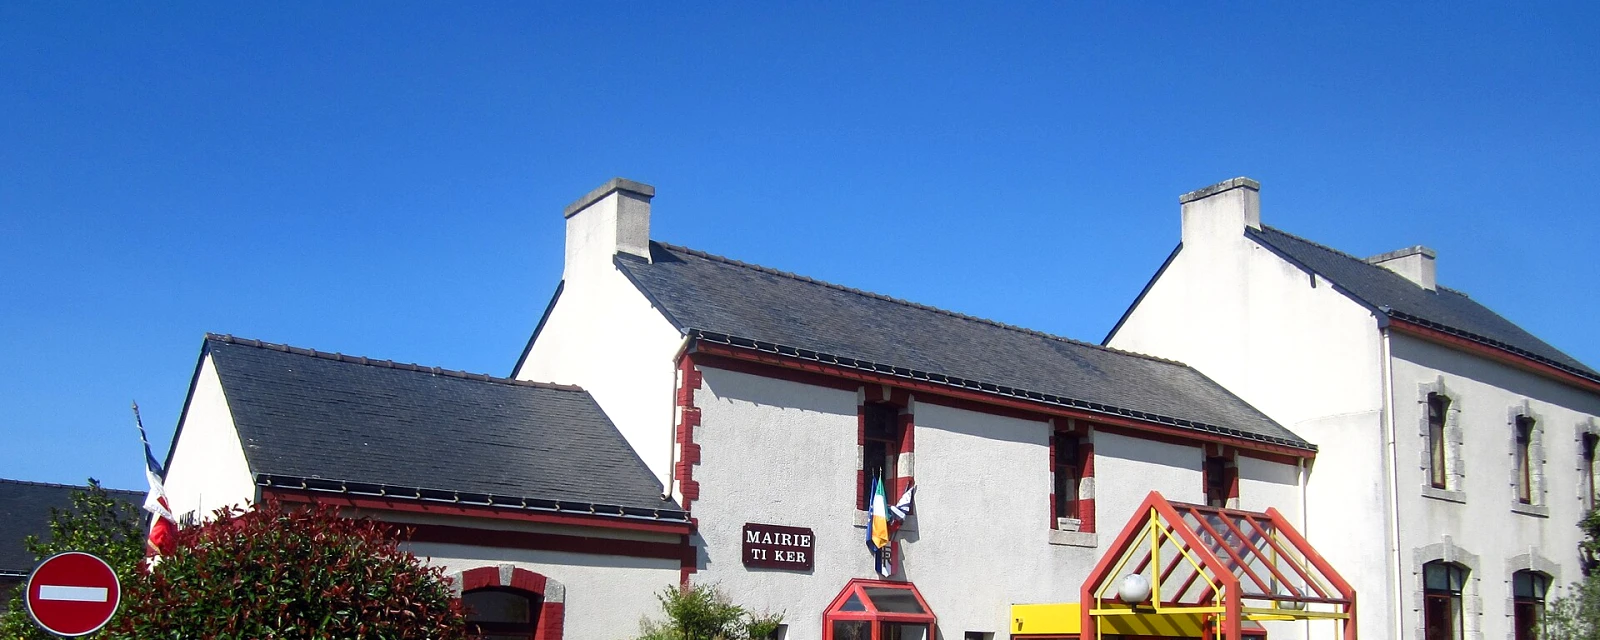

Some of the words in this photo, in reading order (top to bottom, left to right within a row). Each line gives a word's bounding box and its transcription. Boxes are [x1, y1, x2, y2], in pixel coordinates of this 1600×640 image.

[746, 530, 811, 547] MAIRIE
[751, 549, 767, 560] TI
[774, 550, 806, 563] KER
